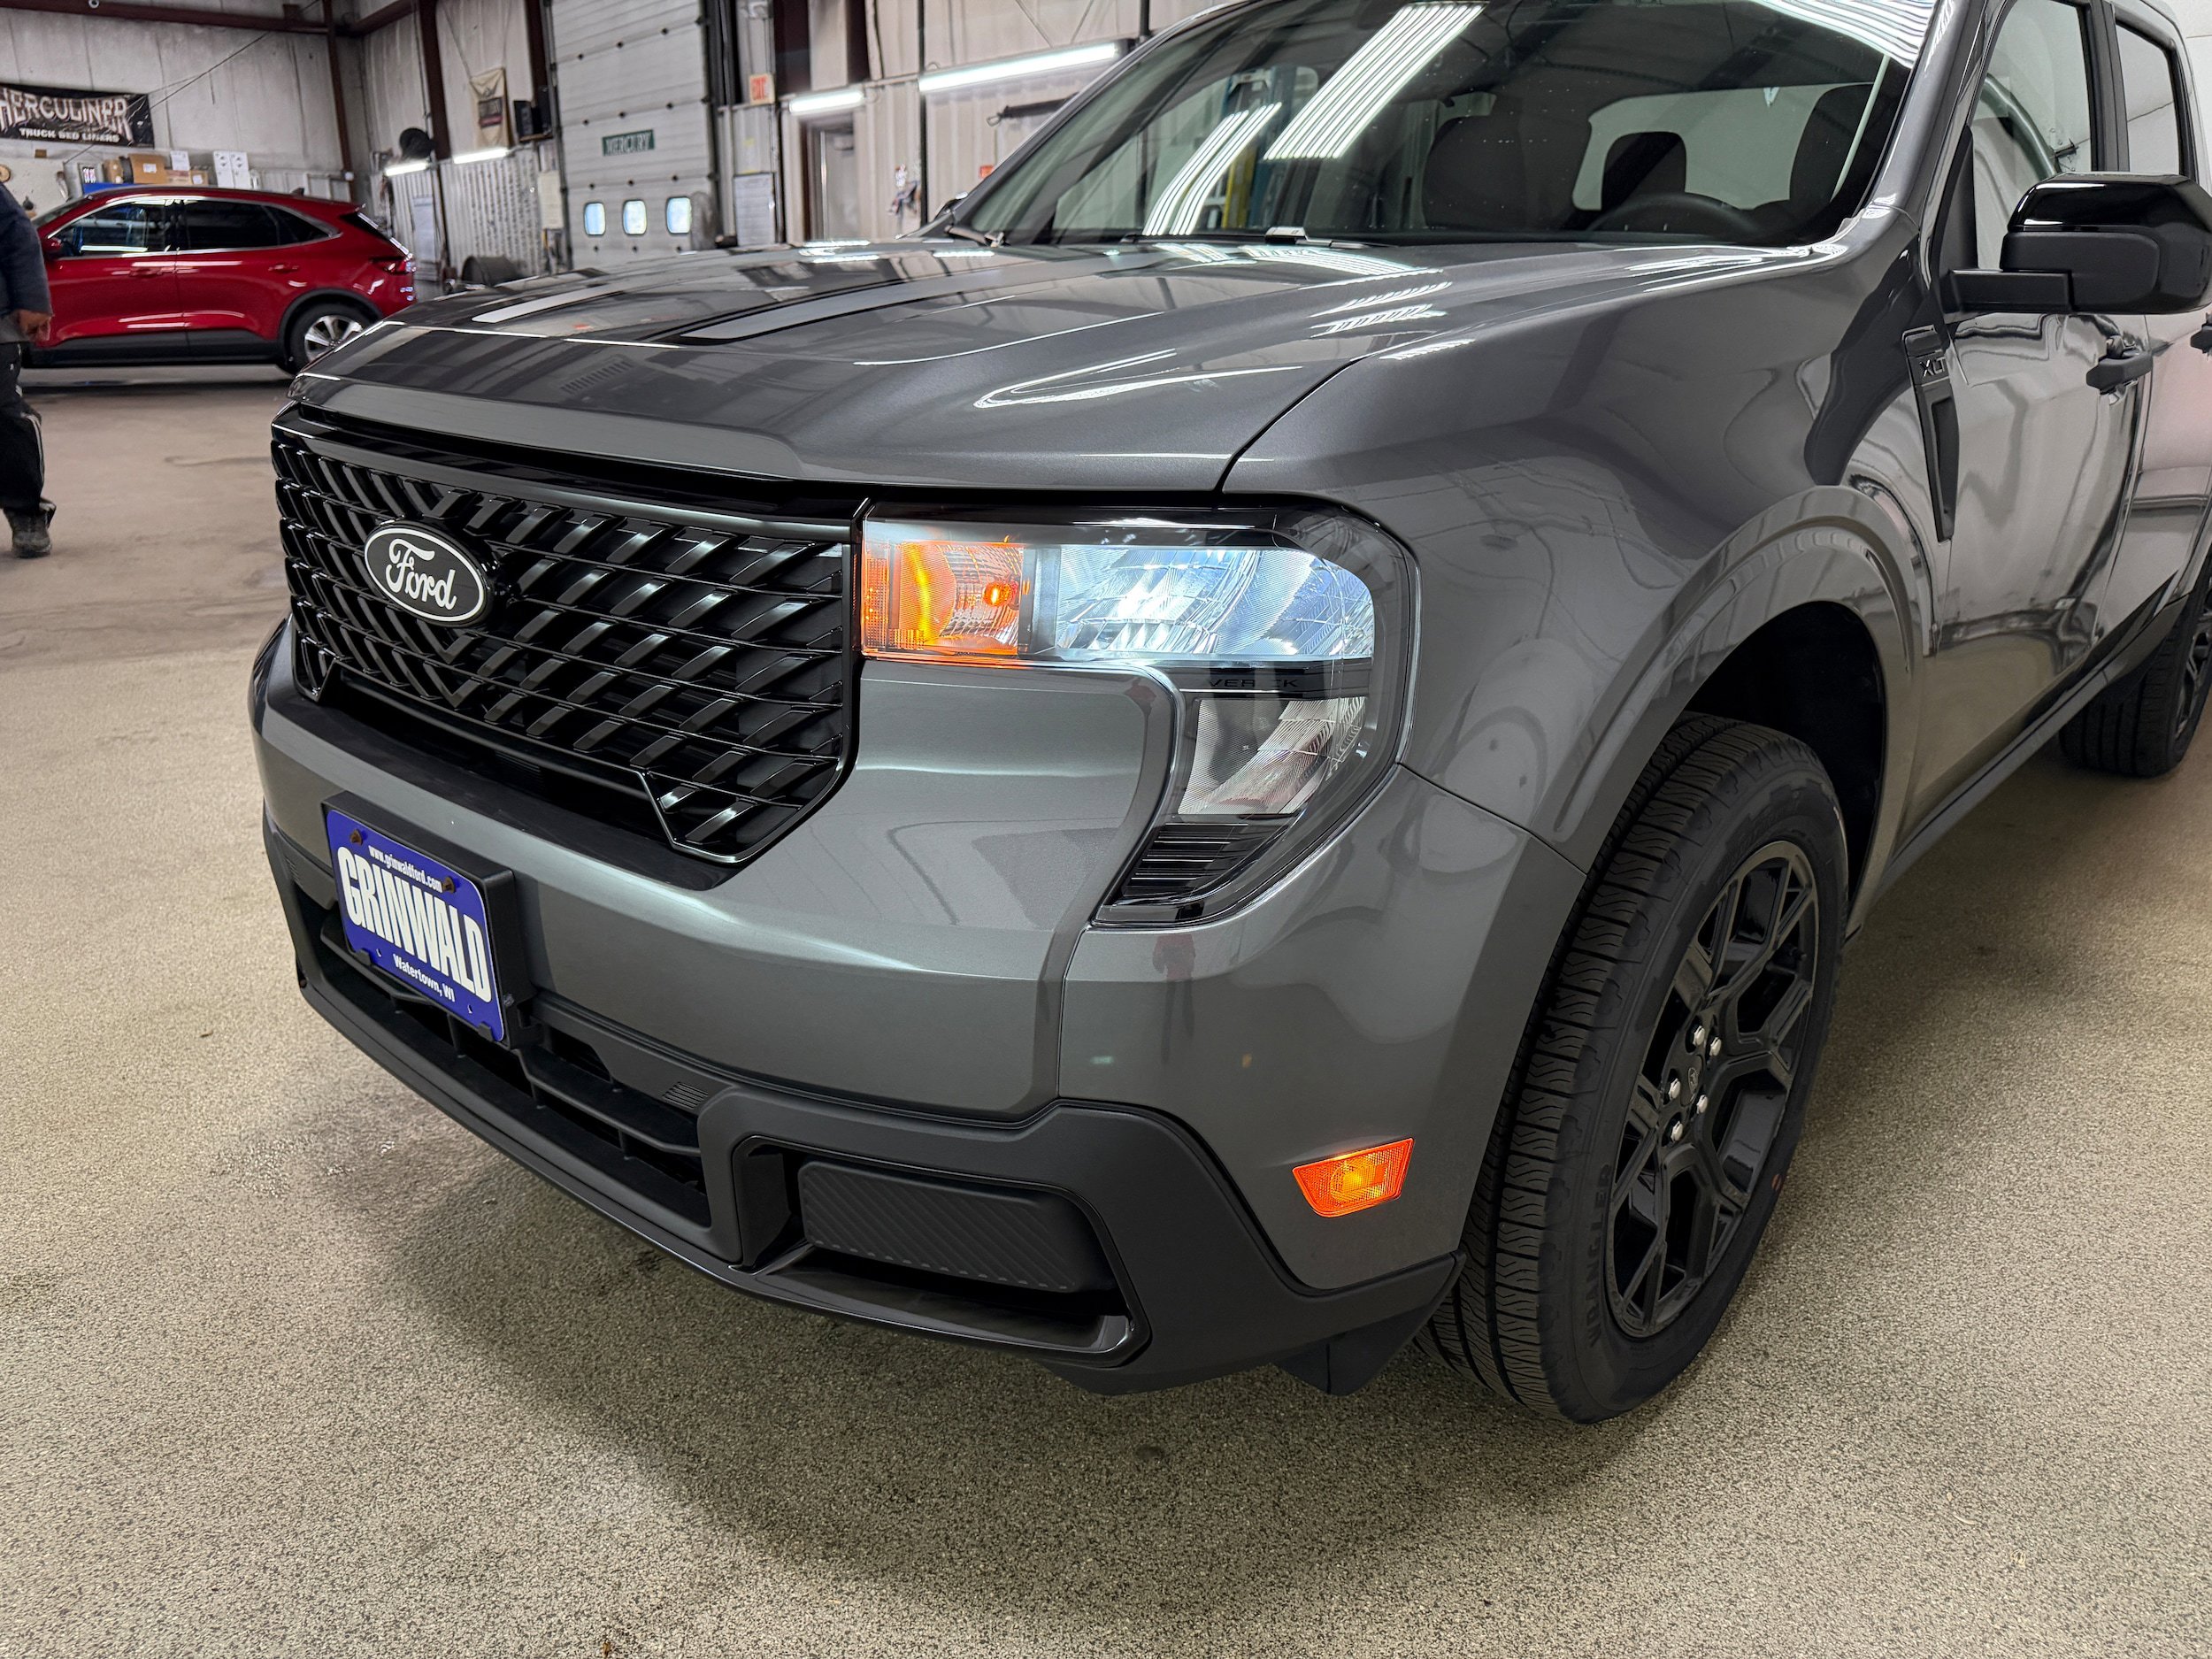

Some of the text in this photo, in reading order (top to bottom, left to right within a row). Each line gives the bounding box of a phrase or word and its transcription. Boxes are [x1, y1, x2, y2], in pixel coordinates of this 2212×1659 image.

[19, 127, 57, 139] TRUCK
[58, 130, 81, 141] BED
[605, 132, 652, 157] MERCURY
[1919, 356, 1948, 377] XLT
[386, 539, 457, 611] Ford
[368, 845, 442, 894] www.grinwaldford.com
[337, 846, 492, 1003] GRINWALD
[393, 953, 456, 1002] Watertown, WI
[1585, 1164, 1612, 1348] WRANGLER
